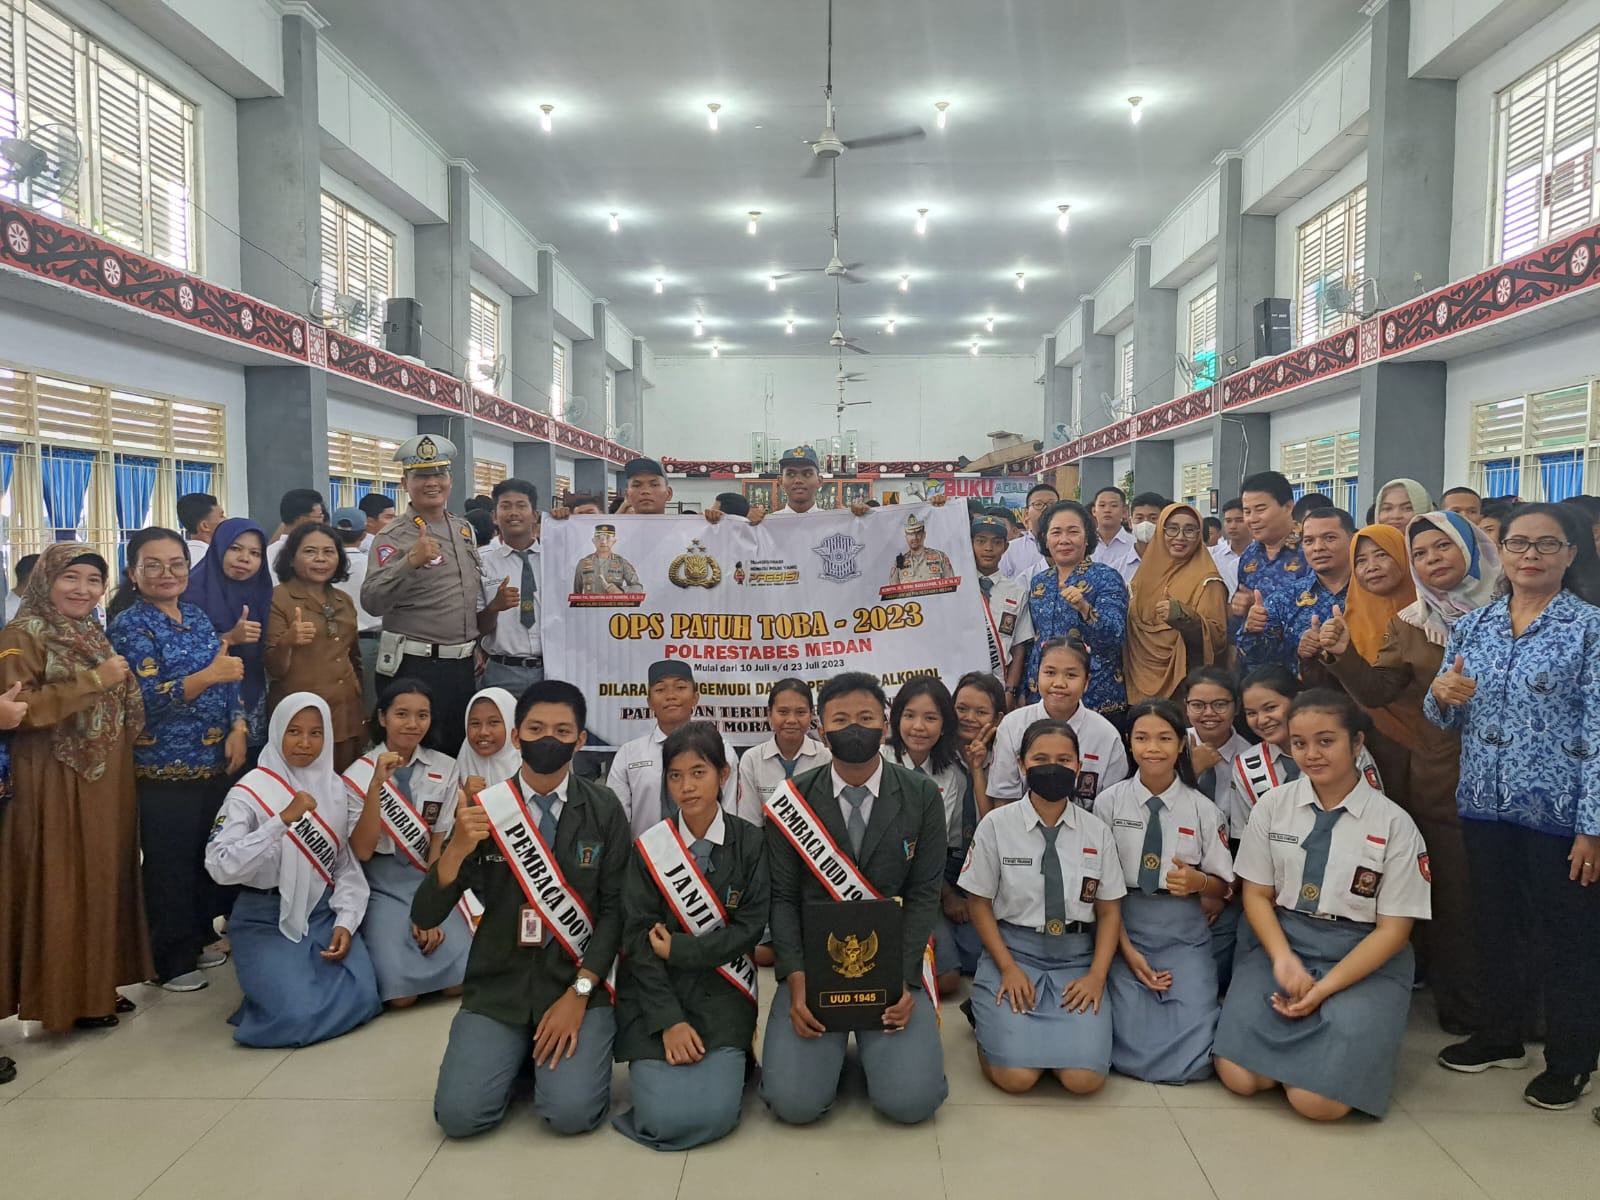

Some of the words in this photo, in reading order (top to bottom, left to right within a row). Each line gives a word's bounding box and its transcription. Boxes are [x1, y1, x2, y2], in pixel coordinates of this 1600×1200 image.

[945, 479, 993, 497] BUKU
[609, 613, 664, 639] OPS
[671, 614, 751, 640] PATUH
[758, 611, 829, 640] TOBA
[853, 602, 923, 633] 2023
[665, 644, 800, 660] POLRESTABES
[805, 638, 872, 657] MEDAN
[694, 663, 718, 672] Mulai
[720, 663, 737, 672] dari
[741, 664, 752, 672] 10
[754, 663, 770, 672] Juli
[772, 662, 788, 672] s/d
[791, 662, 802, 671] 23
[805, 661, 820, 670] Juli
[821, 659, 845, 669] 2023
[599, 683, 648, 696] DILARA
[720, 706, 769, 718] TERTI
[724, 721, 772, 732] MORA
[772, 794, 826, 861] PEMBACA
[819, 855, 848, 886] UUD
[842, 884, 864, 900] 19
[505, 822, 566, 912] PEMBACA
[664, 862, 715, 929] JANJI
[830, 994, 851, 1004] UUD
[854, 992, 876, 1003] 1945
